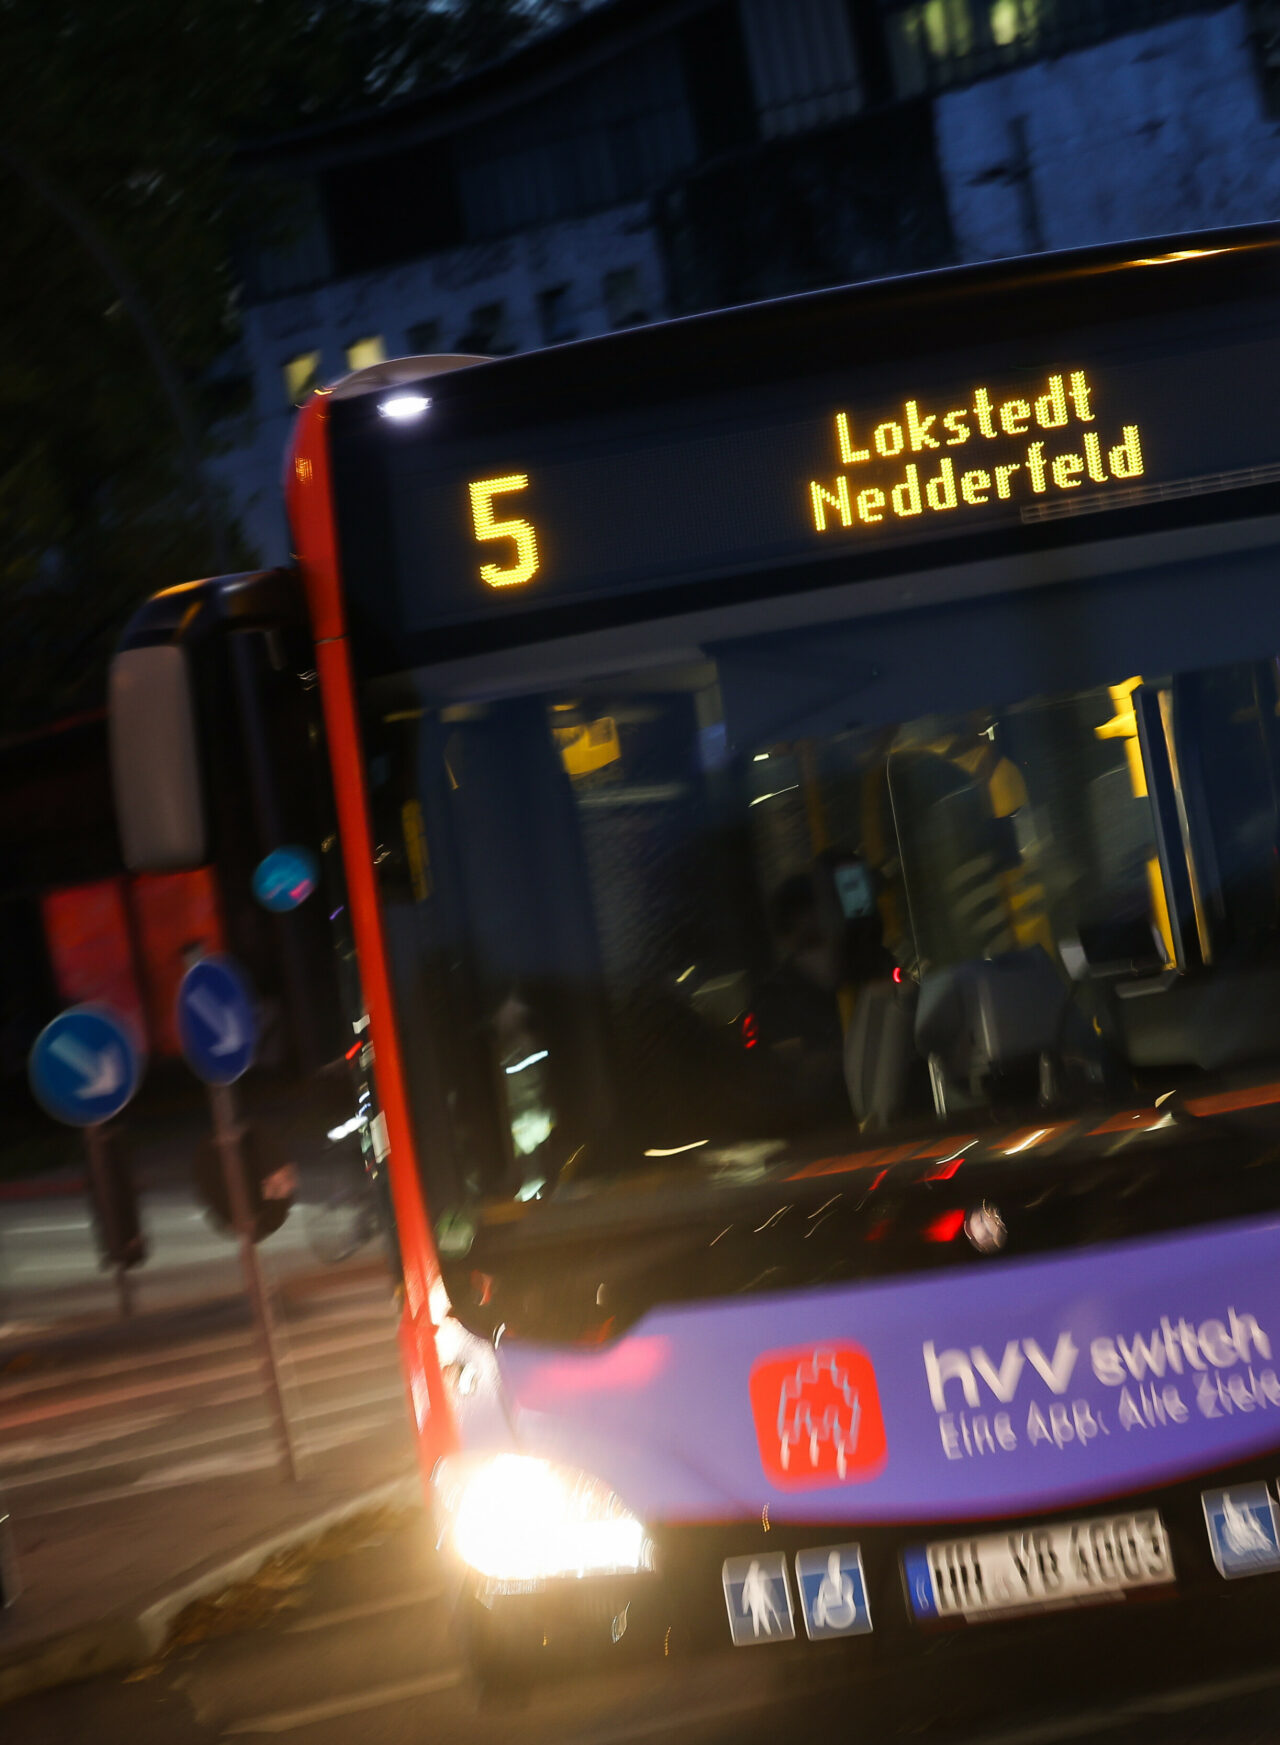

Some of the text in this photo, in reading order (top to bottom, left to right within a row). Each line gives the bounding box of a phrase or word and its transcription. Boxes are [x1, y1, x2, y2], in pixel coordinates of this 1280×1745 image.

[836, 370, 1096, 464] Lokstedt
[468, 474, 540, 588] 5
[809, 425, 1145, 532] Nedderfeld
[922, 1305, 1272, 1413] hvv switch
[939, 1411, 1017, 1460] Eine
[1118, 1381, 1189, 1432] Alle
